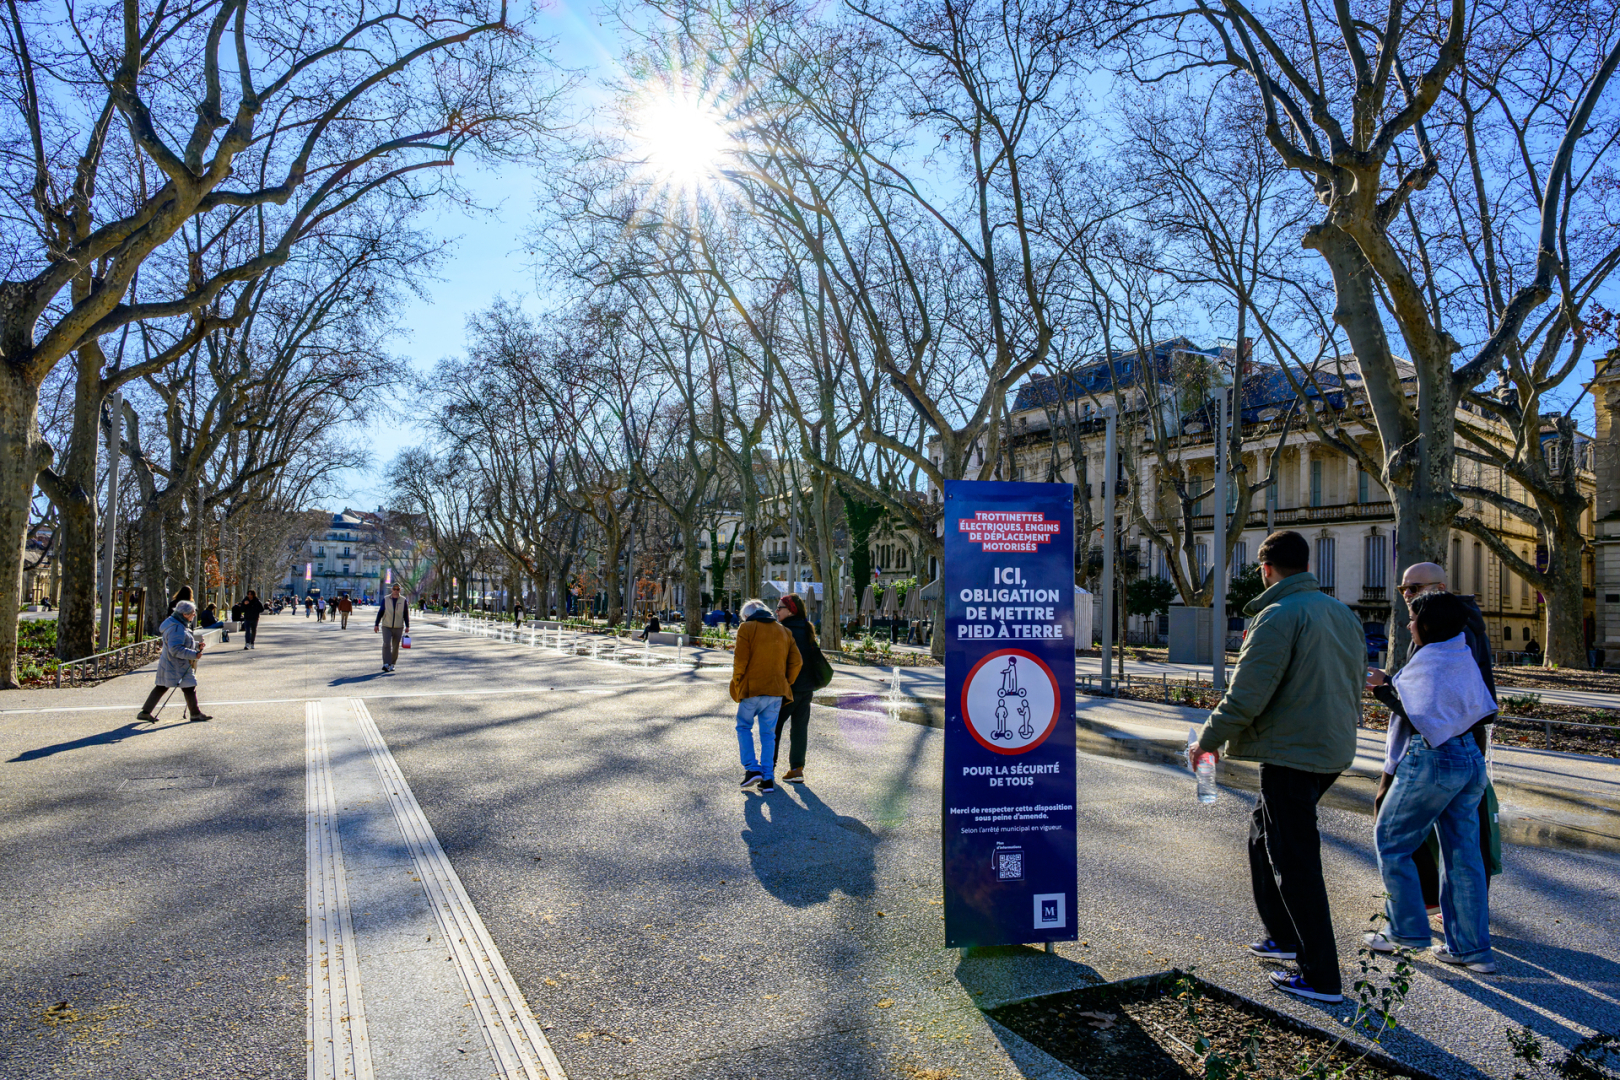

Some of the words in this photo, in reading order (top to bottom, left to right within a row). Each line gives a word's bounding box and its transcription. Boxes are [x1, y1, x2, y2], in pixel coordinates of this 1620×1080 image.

[976, 512, 1044, 522] TROTTINETTES
[960, 520, 1024, 532] ÉLECTRIQUES,
[1025, 523, 1059, 532] ENGINS
[970, 532, 982, 540] DE
[984, 530, 1050, 541] DÉPLACEMENT
[983, 541, 1037, 551] MOTORISÉS
[994, 567, 1027, 588] ICI,
[960, 588, 1060, 602] OBLIGATION
[966, 606, 987, 620] DE
[991, 606, 1054, 620] METTRE
[958, 624, 995, 638] PIED
[998, 620, 1010, 638] À
[1012, 624, 1063, 638] TERRE
[962, 766, 992, 776] POUR
[995, 766, 1008, 775] LA
[1010, 762, 1060, 775] SÉCURITÉ
[990, 777, 1003, 787] DE
[1005, 776, 1034, 786] TOUS
[981, 806, 1014, 814] respecter
[1034, 804, 1073, 812] disposition
[992, 814, 1012, 822] peine
[1045, 906, 1055, 916] M
